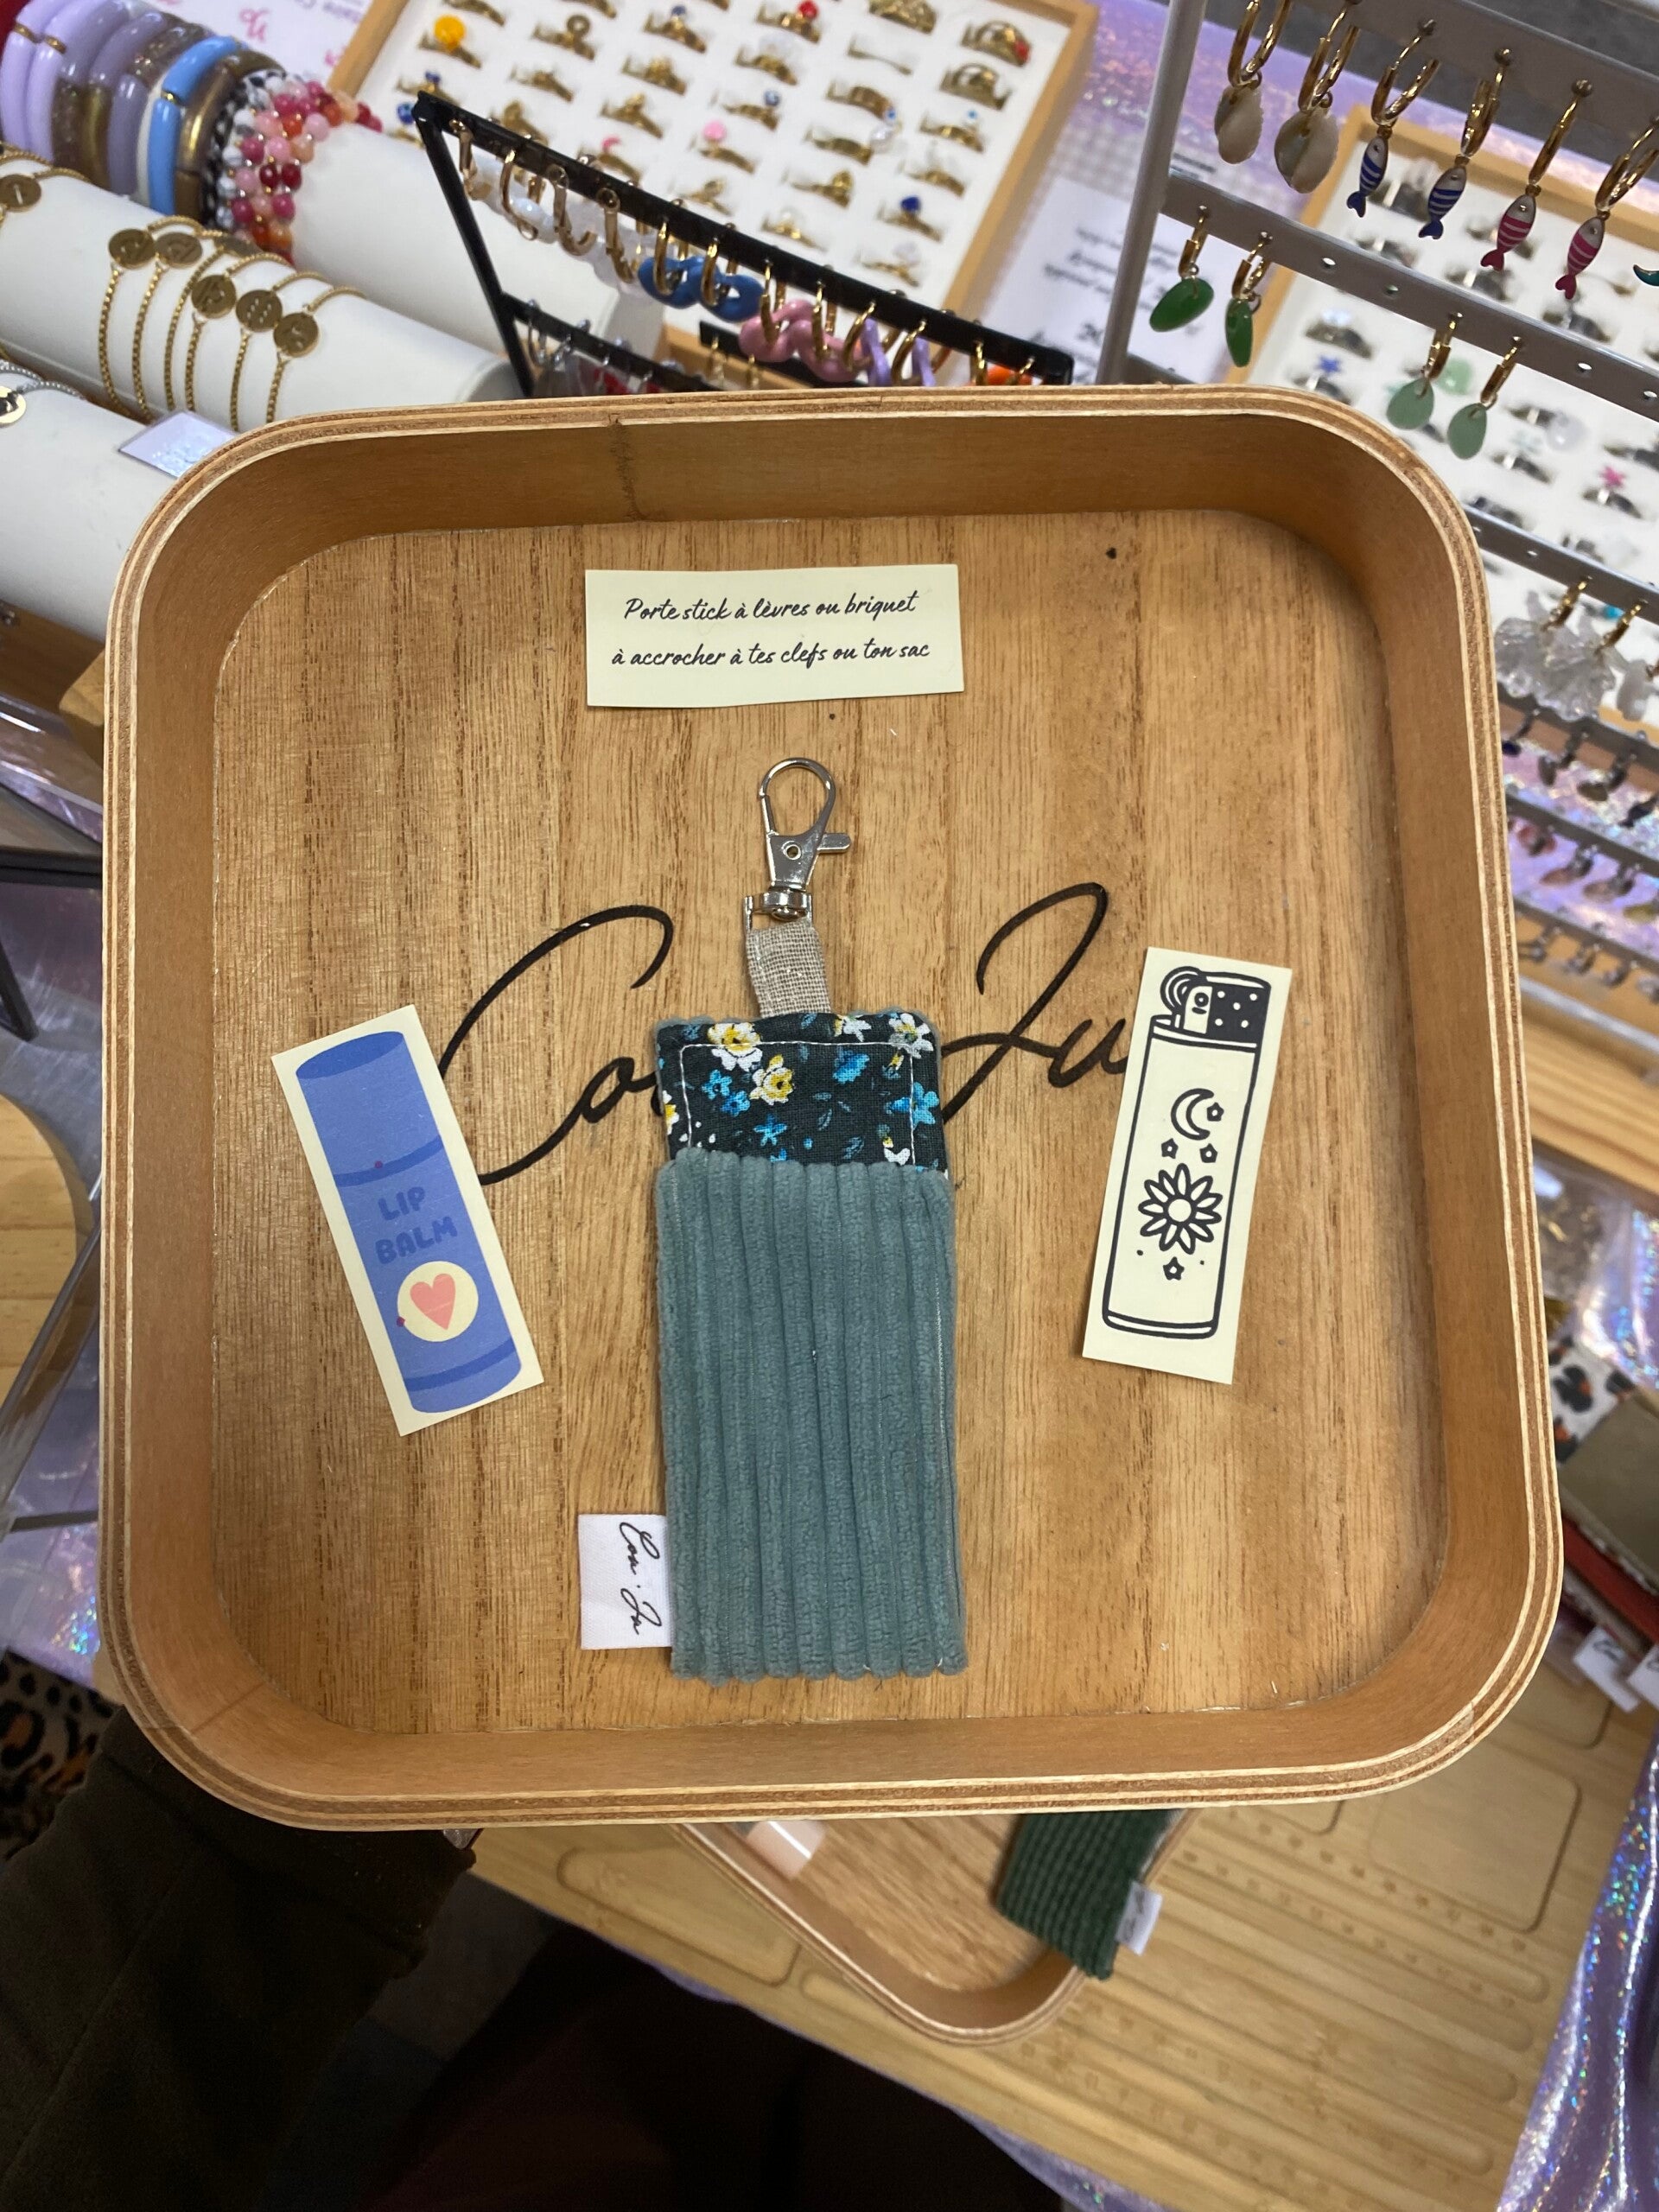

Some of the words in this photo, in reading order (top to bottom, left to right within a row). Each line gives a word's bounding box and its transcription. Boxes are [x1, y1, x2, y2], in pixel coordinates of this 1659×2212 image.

[624, 598, 679, 620] Porte
[682, 597, 734, 620] stick
[734, 602, 748, 620] à
[753, 597, 810, 619] lèvres
[815, 603, 841, 615] ou
[844, 589, 918, 621] briquet
[611, 648, 626, 665] à
[630, 643, 726, 666] accrocher
[729, 648, 744, 665] à
[748, 642, 776, 664] tes
[780, 641, 828, 669] clefs
[832, 648, 858, 660] ou
[863, 637, 897, 659] ton
[899, 644, 930, 658] sac
[378, 1186, 426, 1220] LIP
[375, 1217, 458, 1264] BALM
